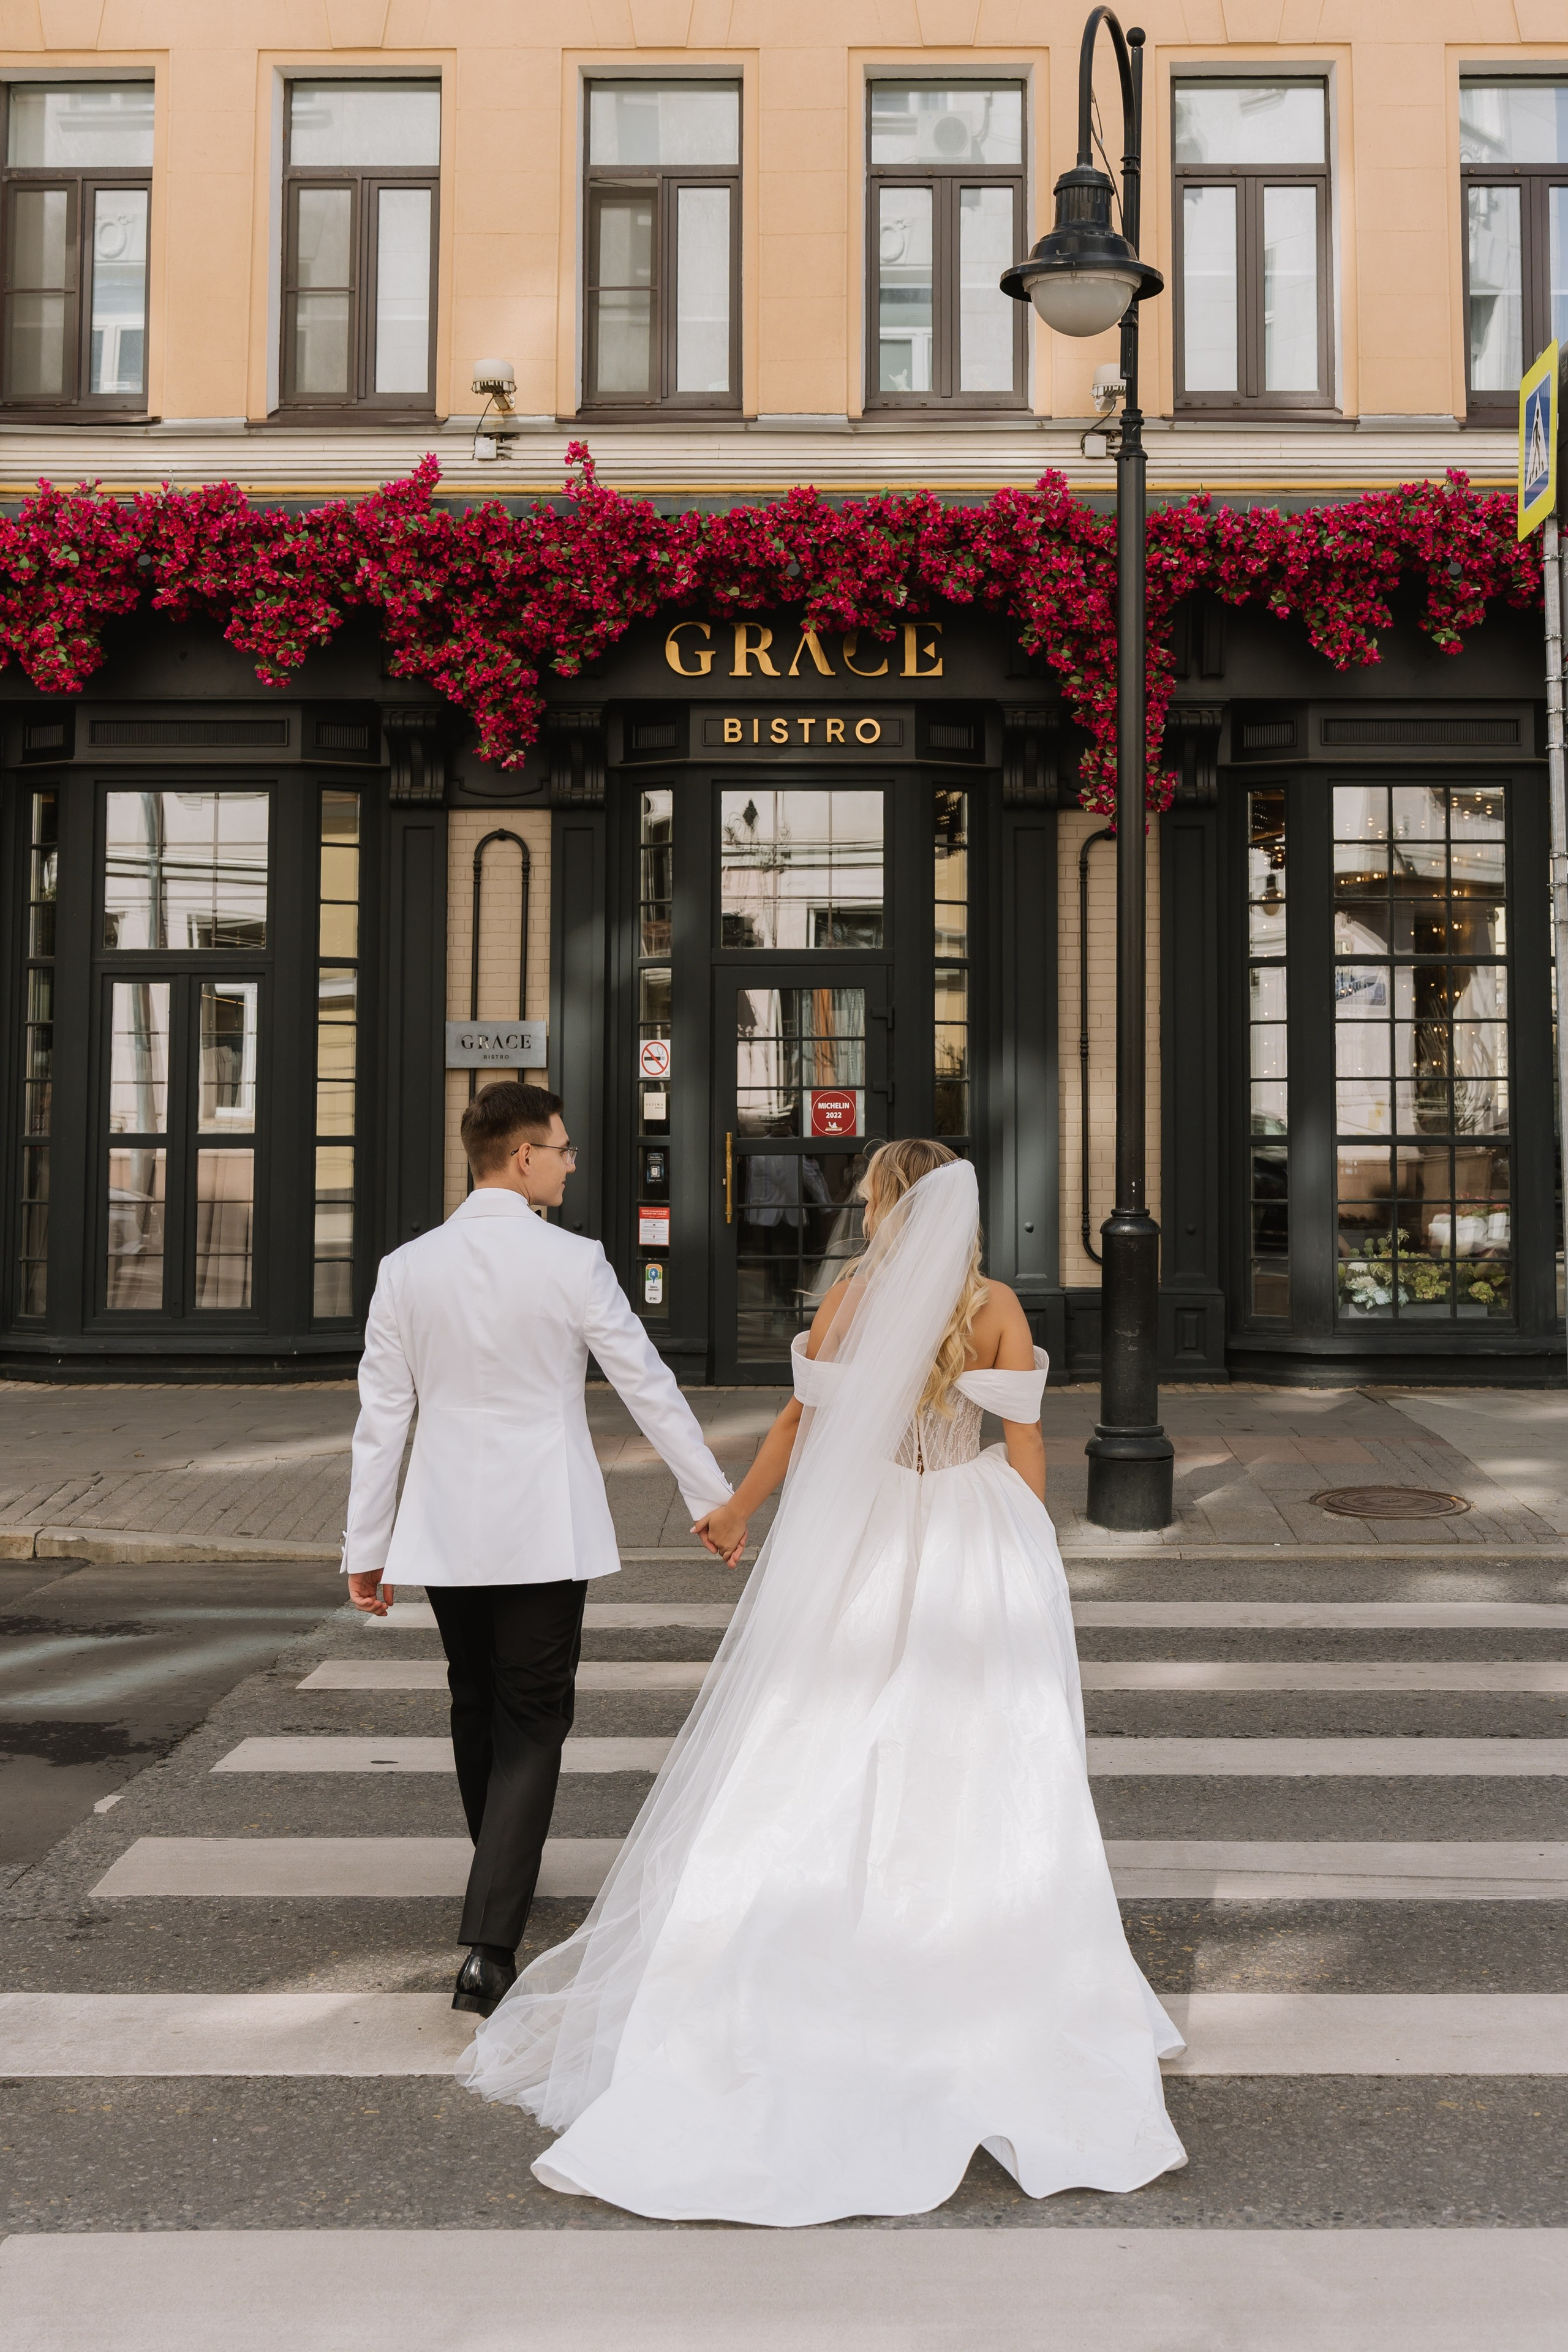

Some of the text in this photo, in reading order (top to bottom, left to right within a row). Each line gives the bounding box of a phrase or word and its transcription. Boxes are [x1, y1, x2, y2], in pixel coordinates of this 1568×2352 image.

[665, 621, 943, 677] GRACE
[723, 718, 881, 744] BISTRO
[461, 1034, 532, 1049] GRACE
